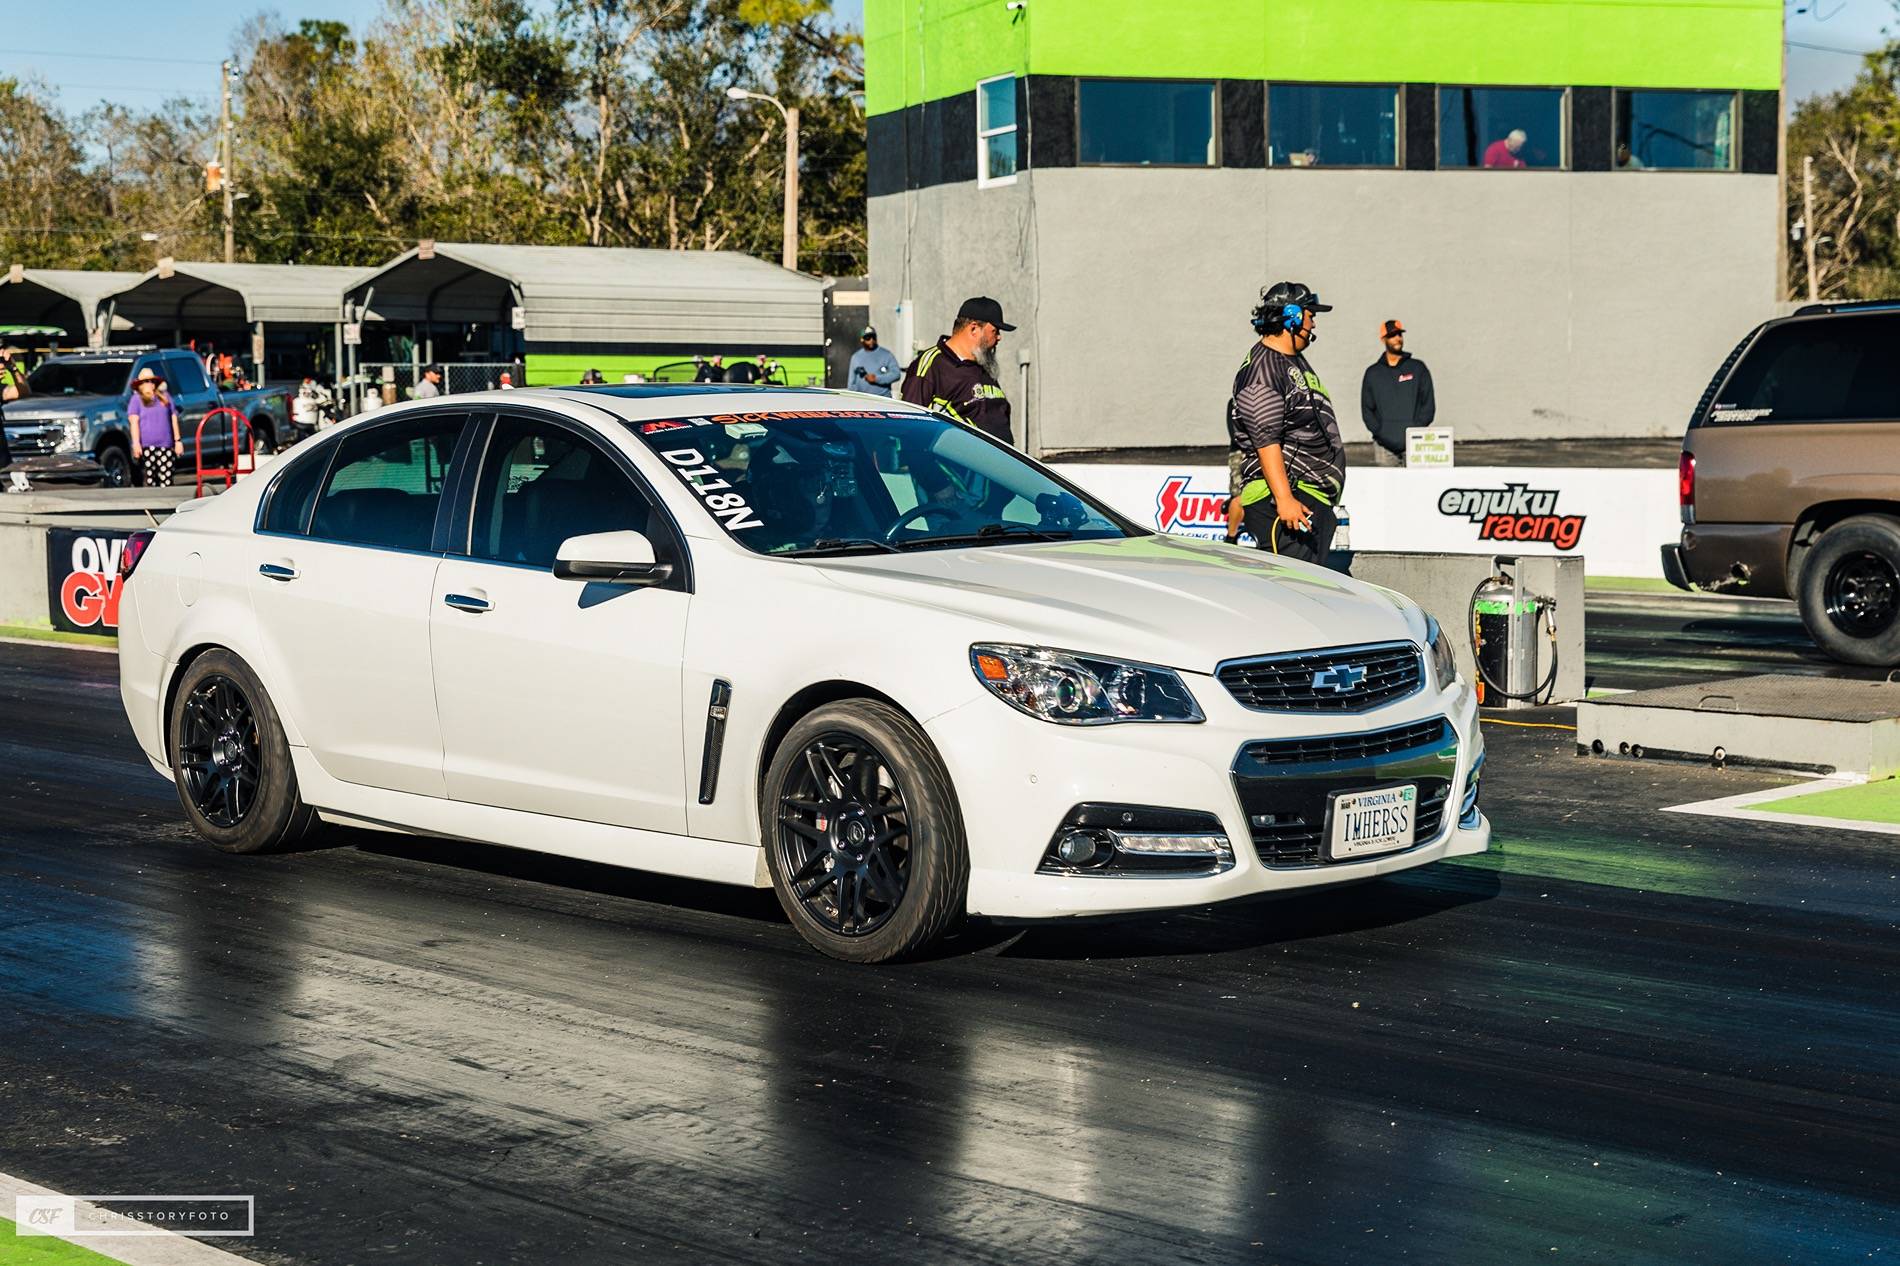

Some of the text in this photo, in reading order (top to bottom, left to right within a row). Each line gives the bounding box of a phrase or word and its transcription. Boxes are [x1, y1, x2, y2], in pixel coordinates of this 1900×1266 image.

[660, 448, 764, 531] D118N
[1160, 481, 1229, 529] SUM
[1439, 485, 1557, 522] enjuku
[1481, 515, 1583, 549] racing
[72, 537, 127, 581] OV
[1357, 793, 1397, 807] VIRGINIA
[1344, 805, 1409, 842] IMHERSS
